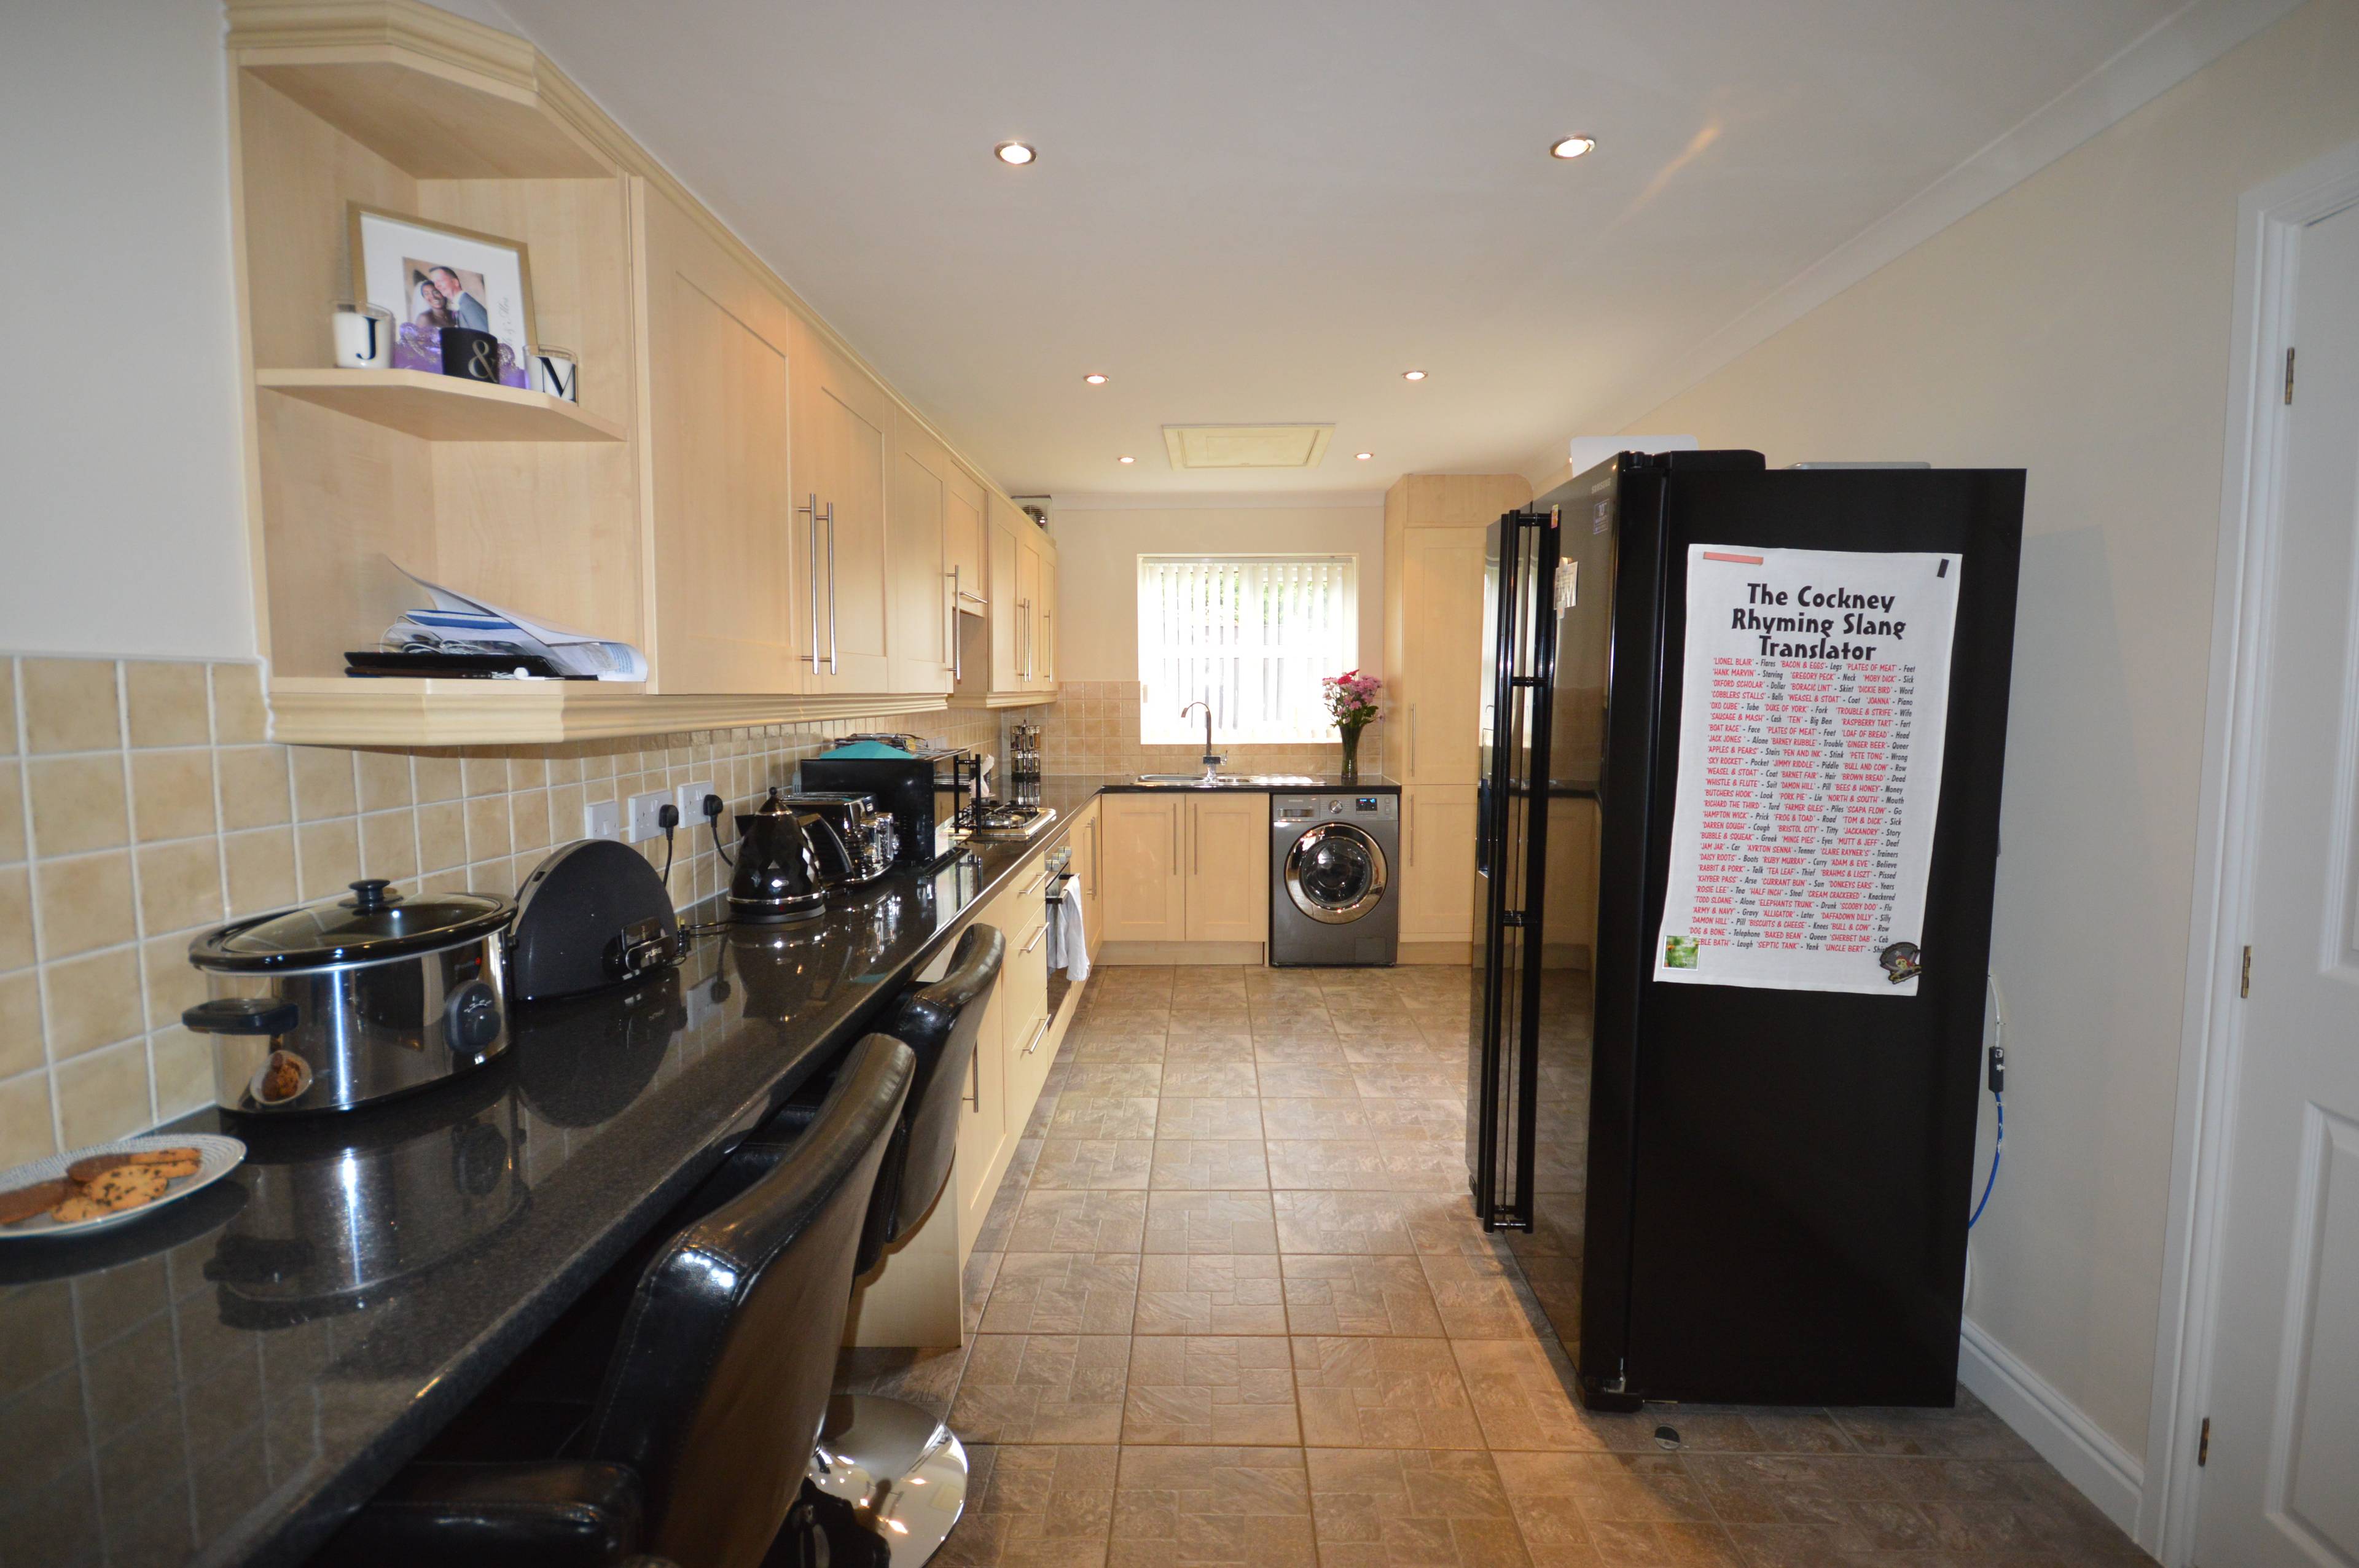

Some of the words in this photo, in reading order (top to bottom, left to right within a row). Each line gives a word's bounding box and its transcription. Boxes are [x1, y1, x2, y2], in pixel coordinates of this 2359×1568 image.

[356, 316, 380, 360] J
[467, 340, 498, 383] &
[538, 356, 576, 403] M
[1747, 583, 1788, 606] The
[1798, 585, 1895, 613] Cockney
[1732, 608, 1834, 638] Rhyming
[1843, 613, 1906, 640] Slang
[1759, 635, 1877, 660] Translator
[1830, 663, 1842, 671] Legs
[1892, 753, 1908, 762] Wrong
[1885, 786, 1903, 795] Money
[1753, 824, 1770, 833] Cough
[1827, 826, 1838, 835] Titty
[1886, 829, 1901, 838] Story
[1822, 837, 1833, 846] Eyes
[1813, 858, 1827, 867] Curry
[1742, 908, 1758, 918] Gravy
[1880, 914, 1891, 923] Silly
[1737, 940, 1753, 950] Laugh
[645, 947, 662, 958] PURE
